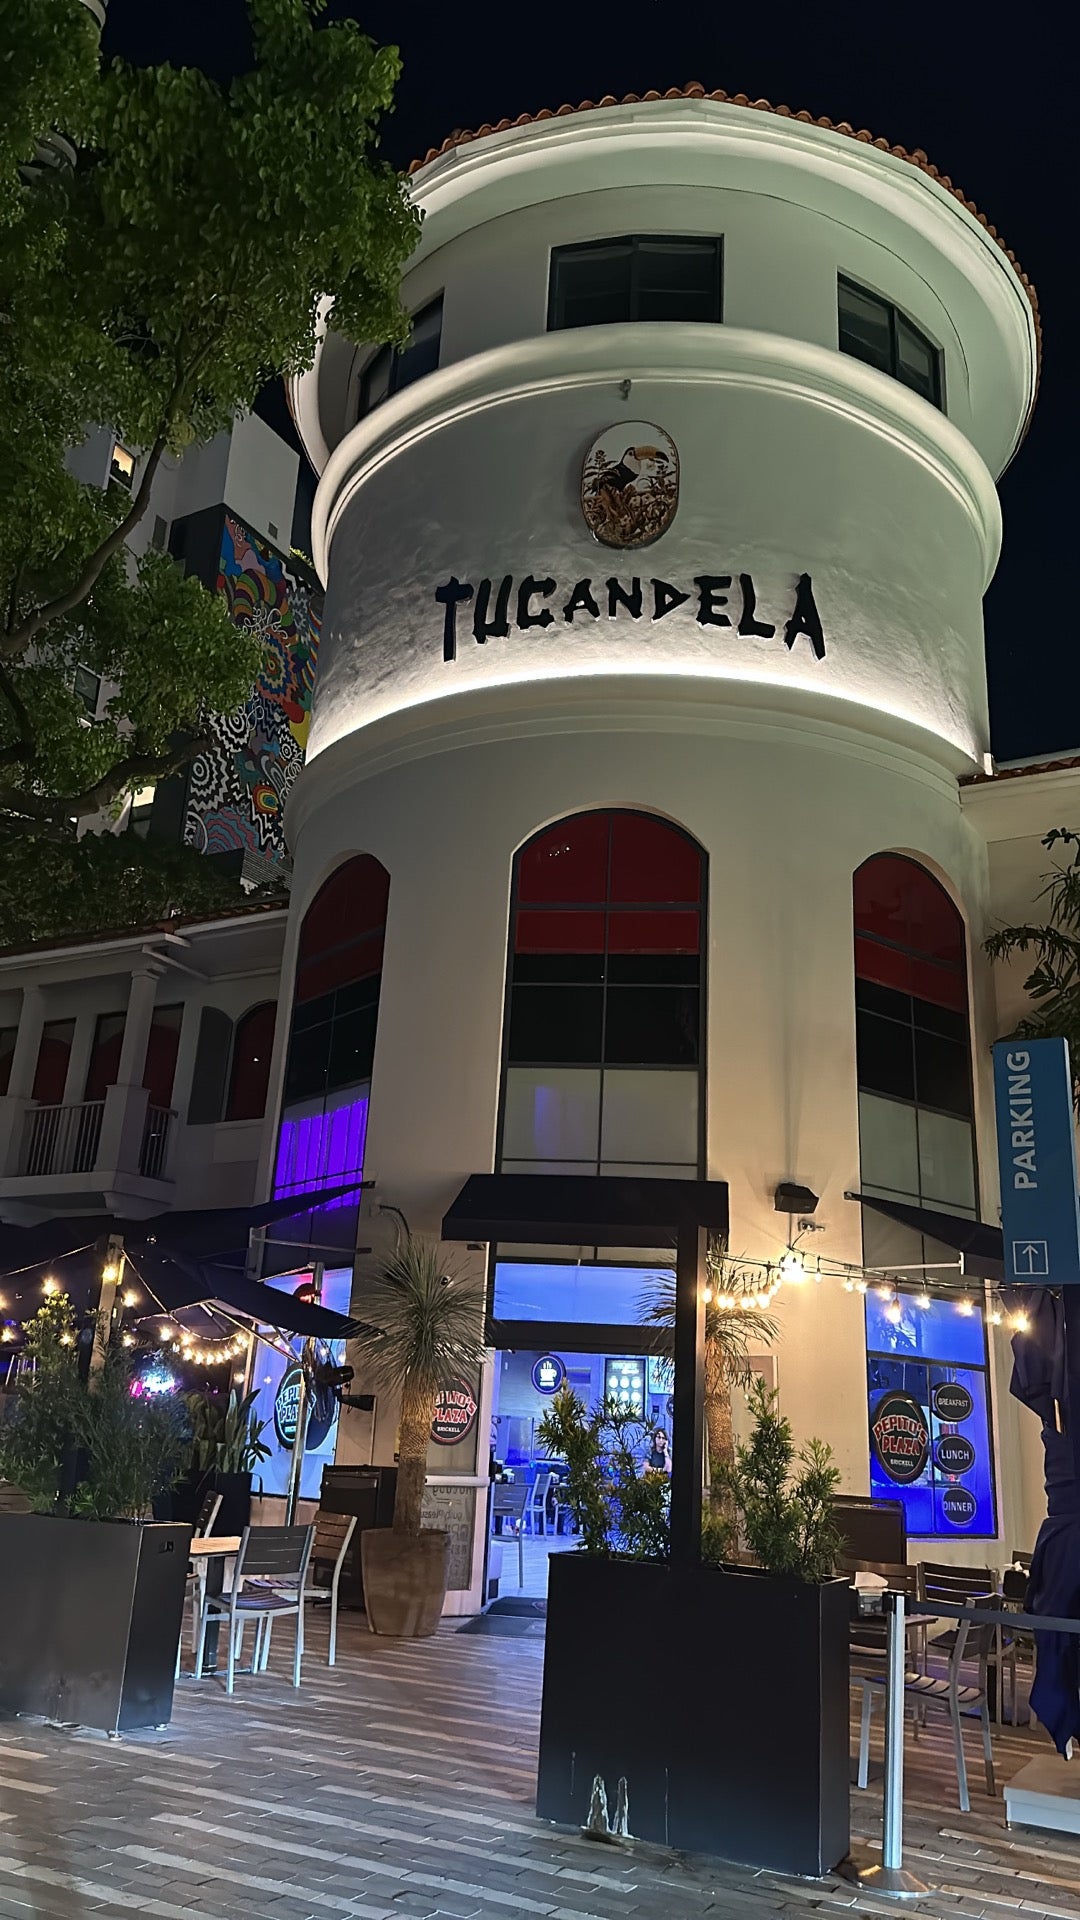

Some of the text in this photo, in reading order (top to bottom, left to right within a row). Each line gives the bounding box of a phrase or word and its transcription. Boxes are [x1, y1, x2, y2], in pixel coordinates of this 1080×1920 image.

[435, 572, 827, 663] TUCANDELA
[1006, 1050, 1038, 1189] PARKING
[938, 1397, 969, 1407] BREAKFAST
[437, 1425, 461, 1433] BRICKELL
[872, 1414, 928, 1447] PEPITO'S
[882, 1434, 920, 1456] PLAZA
[941, 1449, 970, 1460] LUNCH
[943, 1501, 973, 1512] DINNER
